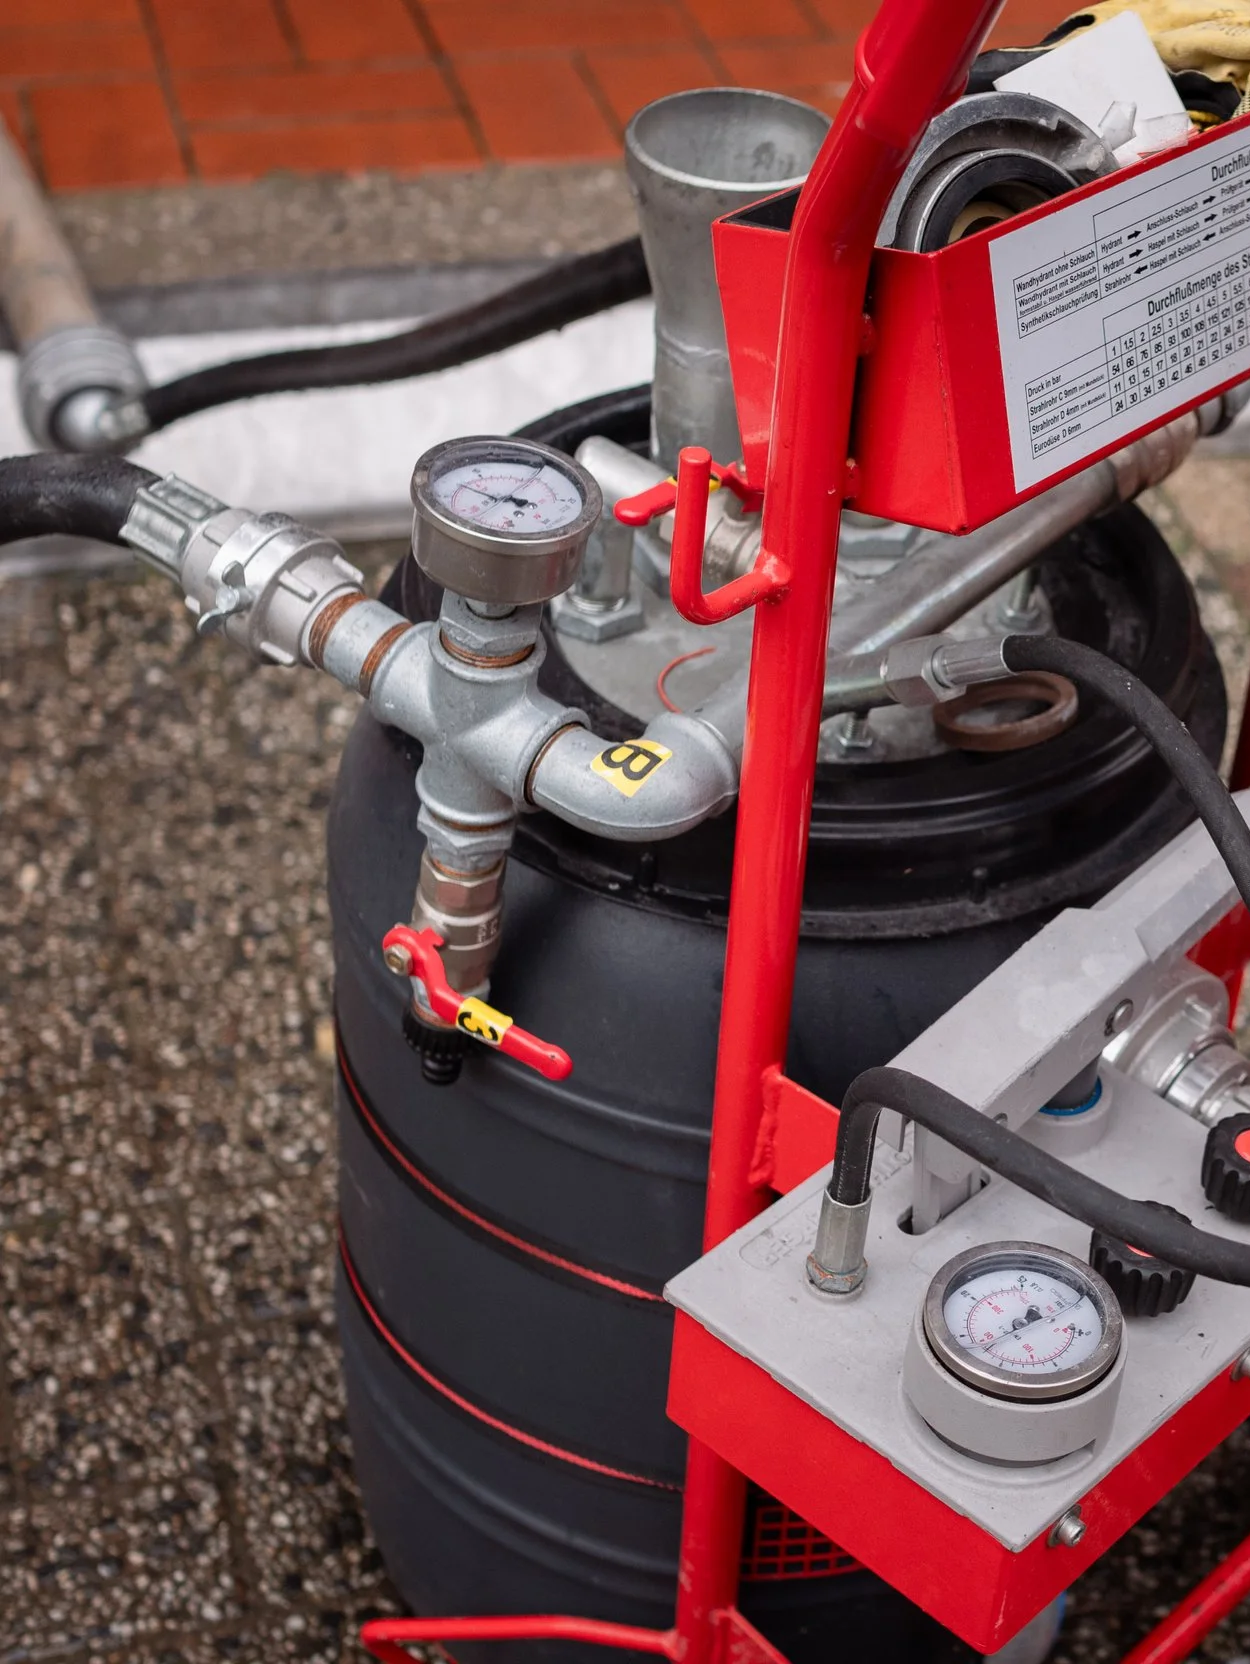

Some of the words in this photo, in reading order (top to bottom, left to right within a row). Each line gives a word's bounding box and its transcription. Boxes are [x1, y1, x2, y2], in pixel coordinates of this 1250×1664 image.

[1101, 236, 1122, 253] Hydrant
[1102, 256, 1124, 273] Hydrant
[1147, 236, 1166, 251] Haspel
[1167, 232, 1175, 242] mit
[1176, 221, 1199, 238] Schlauch
[1104, 273, 1131, 292] Strahlrohr
[1149, 255, 1167, 269] Haspel
[1168, 250, 1176, 260] mit
[1177, 239, 1200, 256] Schlauch
[1016, 268, 1054, 292] Wandhydrant
[1054, 263, 1068, 274] ohne
[1069, 249, 1094, 267] Schlauch
[1018, 283, 1058, 307] Wandhydrant
[1058, 278, 1068, 288] mit
[1069, 266, 1096, 283] Schlauch
[1147, 270, 1221, 316] Durchflußmenge
[1224, 261, 1239, 277] des
[1020, 289, 1098, 332] Synthetikschlauchprüfung
[1112, 345, 1116, 355] 1
[1124, 337, 1133, 349] 1,5
[1140, 331, 1145, 341] 2
[1168, 317, 1173, 327] 3
[1195, 304, 1200, 312] 4
[1222, 290, 1227, 300] 5
[1112, 363, 1120, 375] 54
[1126, 356, 1134, 367] 66
[1140, 348, 1148, 360] 76
[1154, 341, 1162, 353] 85
[1168, 334, 1176, 346] 93
[1180, 327, 1191, 338] 100
[1207, 312, 1218, 325] 115
[1221, 306, 1230, 318] 121
[1113, 381, 1121, 392] 11
[1128, 374, 1135, 385] 13
[1142, 366, 1150, 377] 15
[1156, 359, 1163, 370] 17
[1170, 352, 1177, 363] 18
[1183, 345, 1191, 357] 20
[1196, 339, 1203, 350] 21
[1210, 331, 1217, 343] 22
[1223, 325, 1231, 336] 24
[1237, 317, 1244, 329] 25
[1027, 382, 1044, 397] Druck
[1045, 379, 1051, 388] in
[1051, 374, 1061, 384] bar
[1115, 399, 1123, 411] 24
[1129, 392, 1137, 404] 30
[1143, 385, 1151, 396] 34
[1157, 377, 1165, 389] 39
[1171, 370, 1178, 380] 42
[1184, 363, 1192, 373] 46
[1211, 349, 1219, 360] 52
[1225, 342, 1232, 353] 54
[1238, 335, 1245, 346] 57
[1029, 396, 1057, 415] Strahlrohr
[1058, 391, 1063, 400] C
[1063, 386, 1077, 398] 9mm
[1031, 414, 1059, 434] Strahlrohr
[1060, 410, 1064, 419] D
[1066, 404, 1079, 415] 4mm
[1033, 434, 1060, 453] Eurodüse
[1062, 428, 1066, 438] D
[1067, 423, 1081, 434] 6mm
[601, 744, 662, 781] B
[1022, 1343, 1034, 1353] 100
